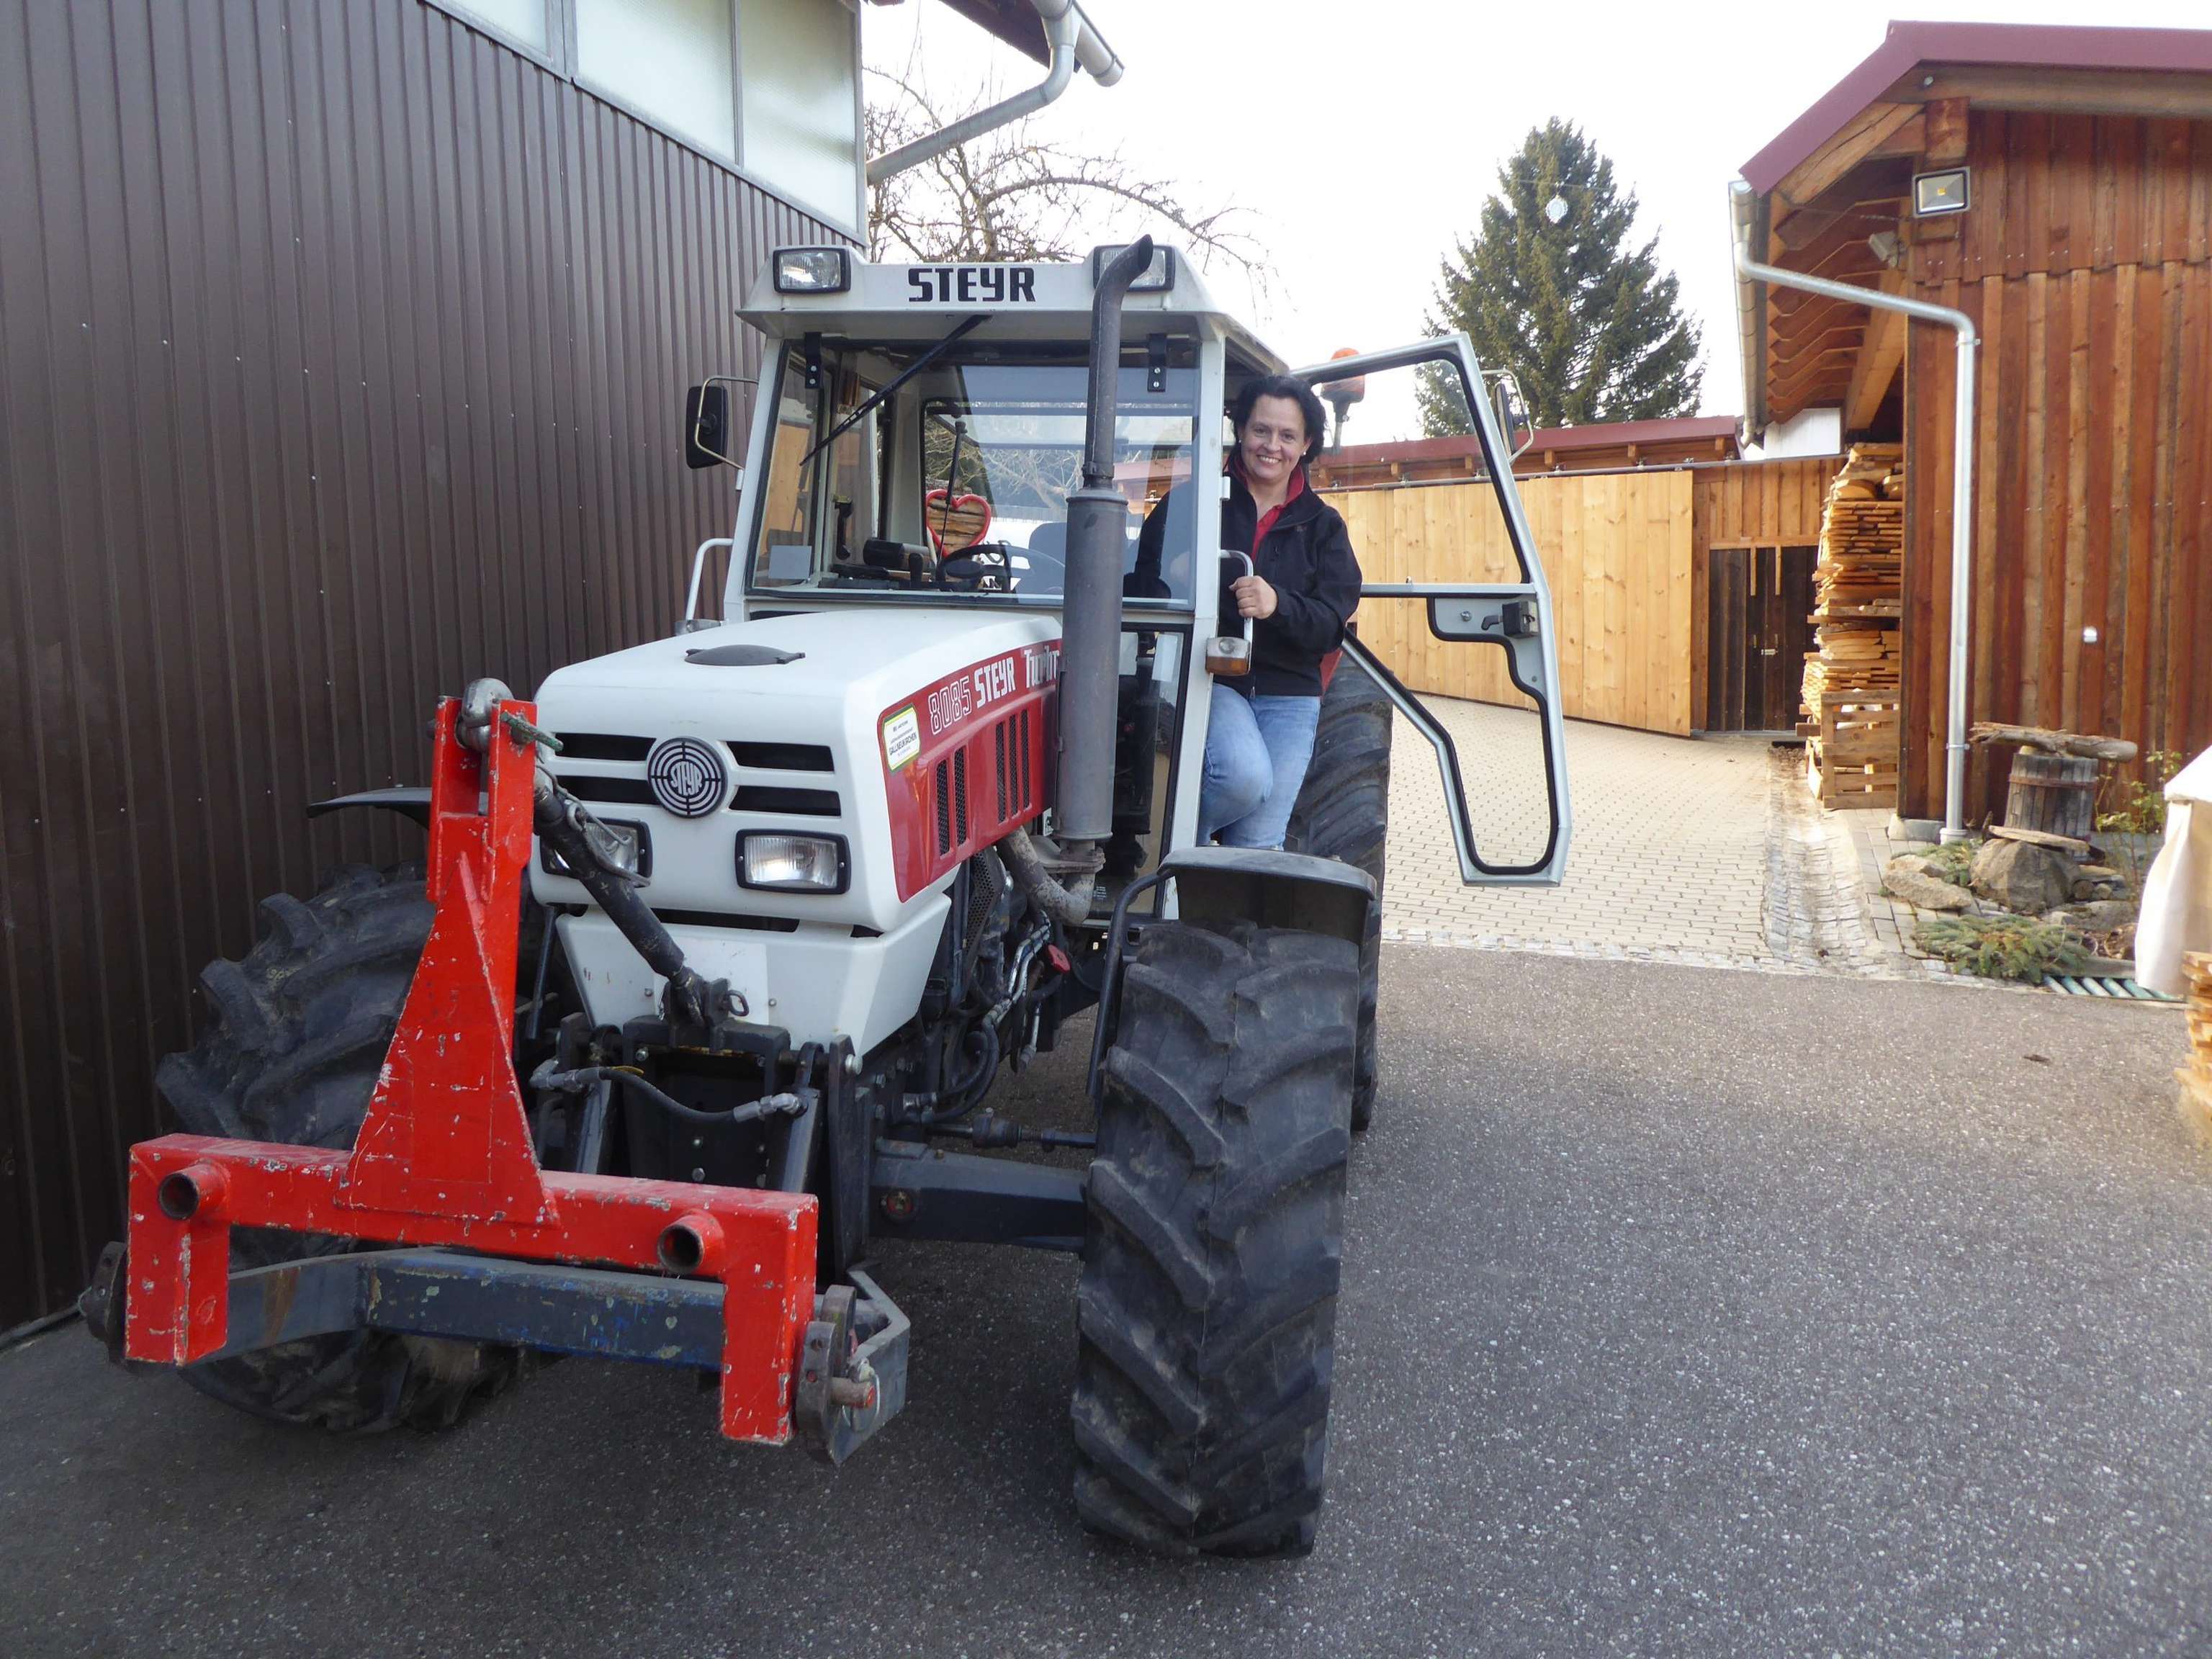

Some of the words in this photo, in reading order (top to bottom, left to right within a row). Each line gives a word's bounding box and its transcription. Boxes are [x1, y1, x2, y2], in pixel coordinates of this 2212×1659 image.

[908, 267, 1036, 302] STEYR
[928, 675, 972, 735] 8085
[974, 657, 1016, 709] STEYR
[670, 761, 703, 796] STEYR
